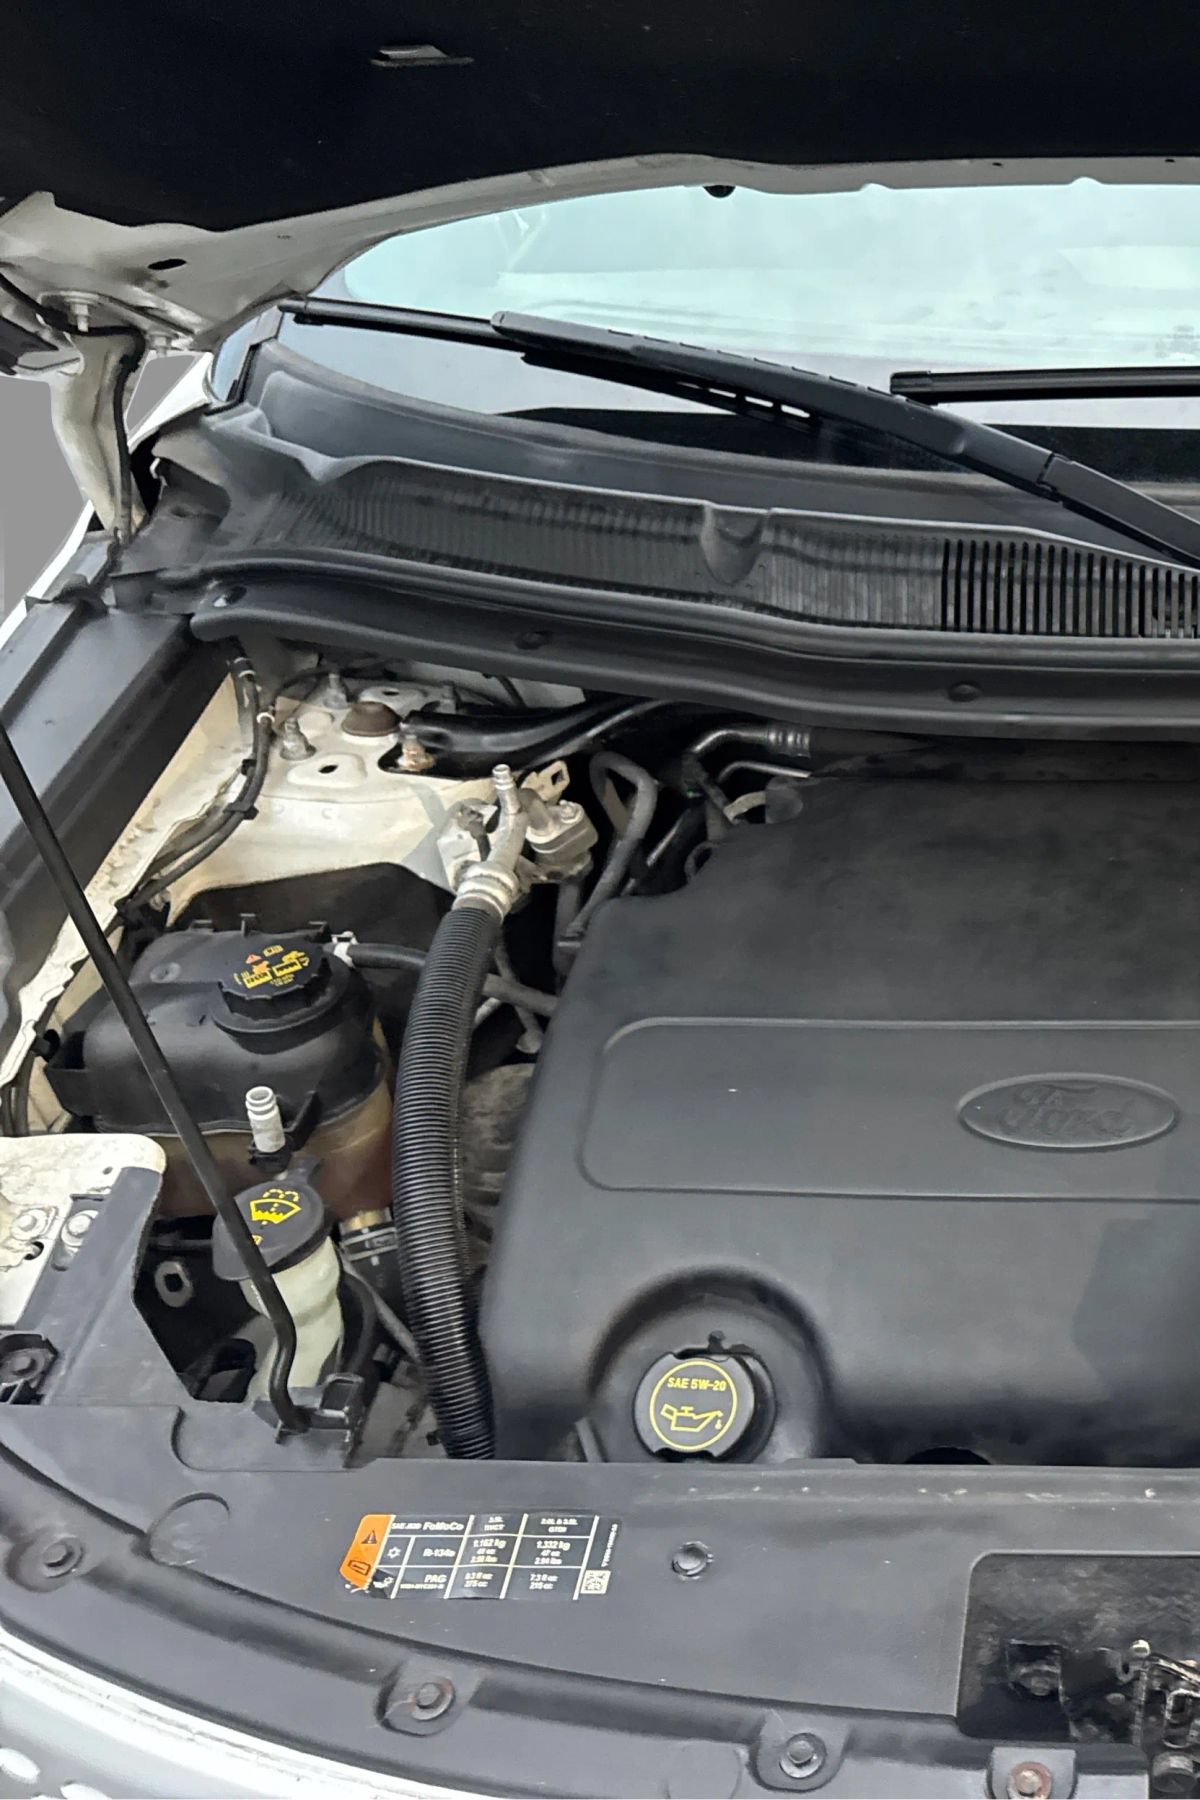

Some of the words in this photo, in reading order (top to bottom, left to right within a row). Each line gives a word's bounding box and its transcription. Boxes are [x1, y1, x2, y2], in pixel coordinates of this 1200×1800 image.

[1000, 1083, 1142, 1138] Ford
[667, 1377, 690, 1389] SAE
[690, 1378, 728, 1392] 5W-20
[422, 1521, 465, 1531] FoMoCo
[424, 1574, 448, 1583] PAG
